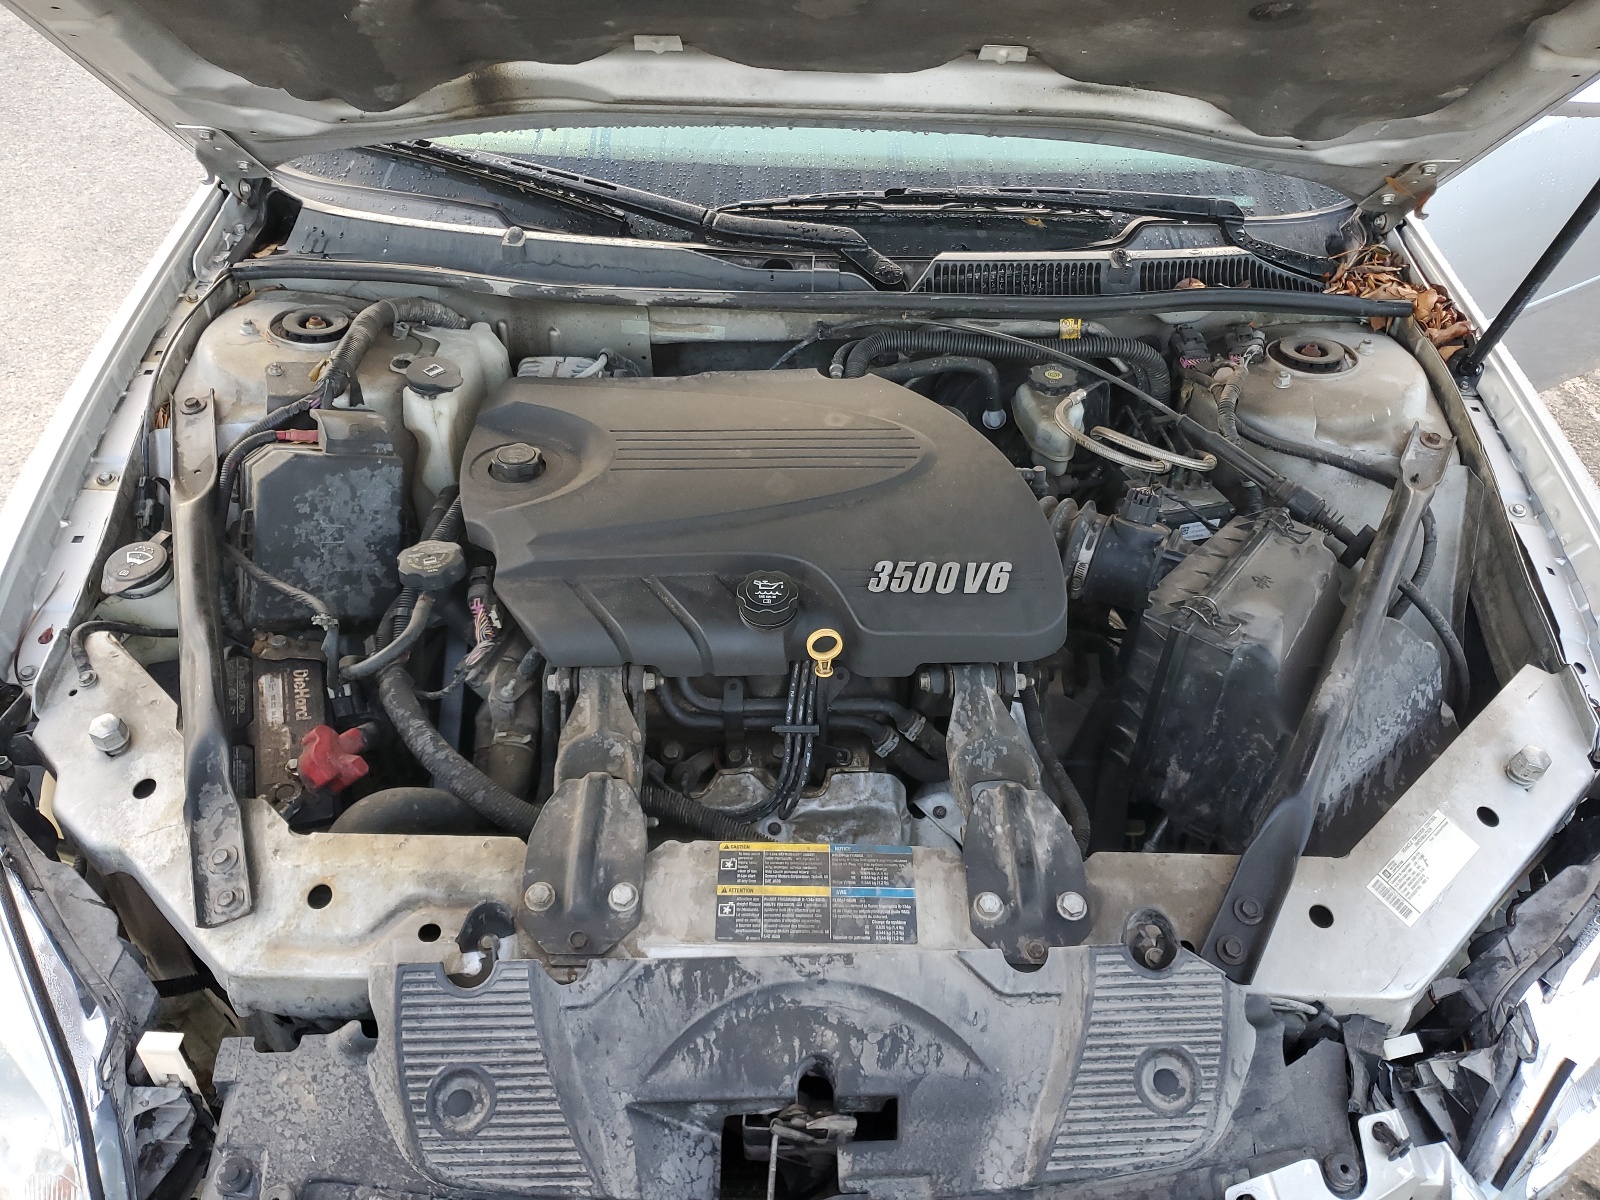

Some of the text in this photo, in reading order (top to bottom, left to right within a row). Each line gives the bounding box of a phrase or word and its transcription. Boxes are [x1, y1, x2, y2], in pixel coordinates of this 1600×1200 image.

[867, 560, 1013, 595] 3500 V6
[292, 669, 312, 721] DieHard
